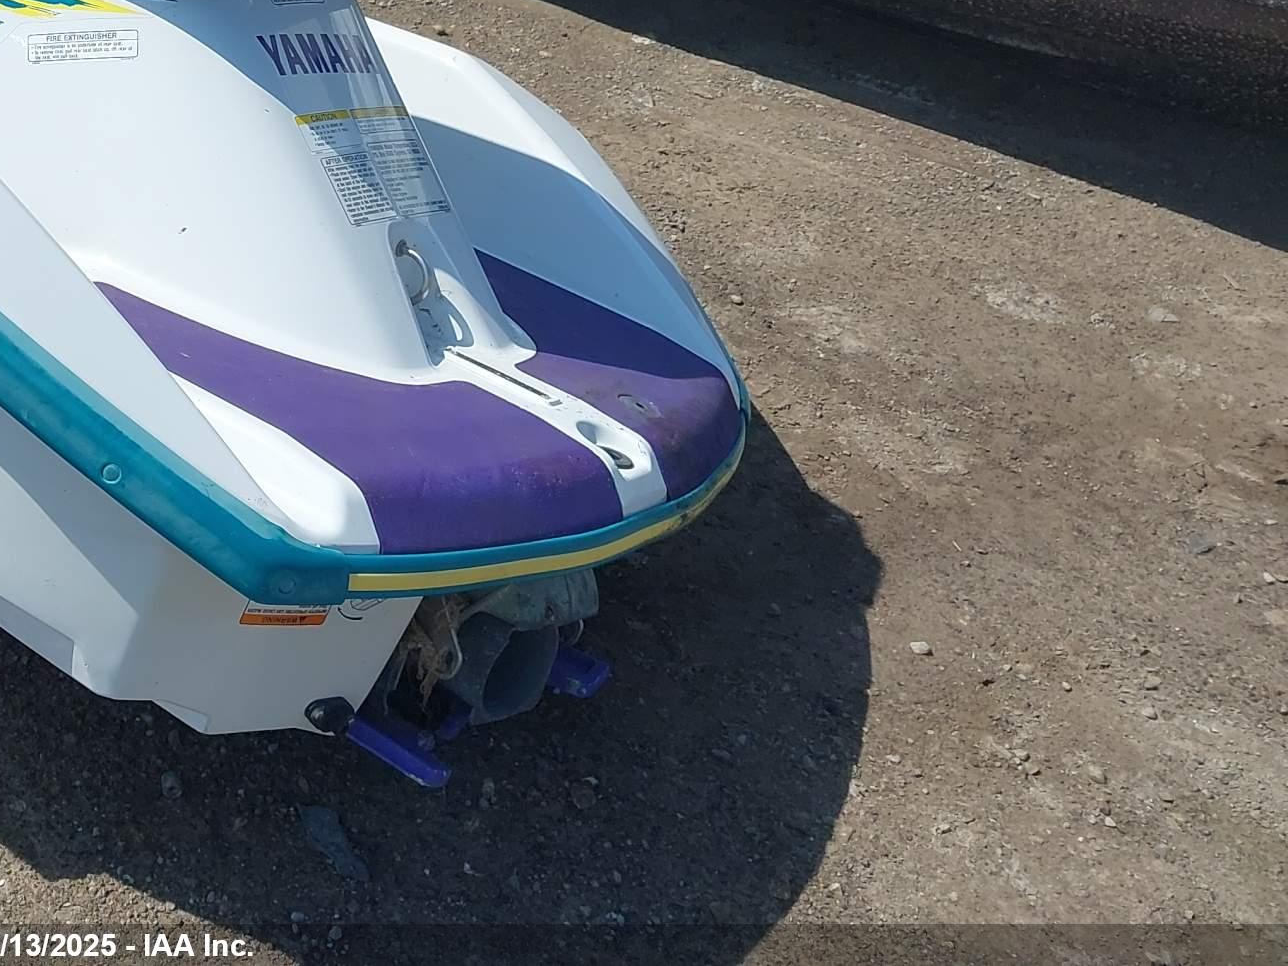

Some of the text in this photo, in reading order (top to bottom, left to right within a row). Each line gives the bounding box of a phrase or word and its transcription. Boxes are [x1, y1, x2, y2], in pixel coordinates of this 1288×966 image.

[45, 32, 118, 43] FIRE EXTINGUISHER
[255, 33, 374, 76] YAMAHA
